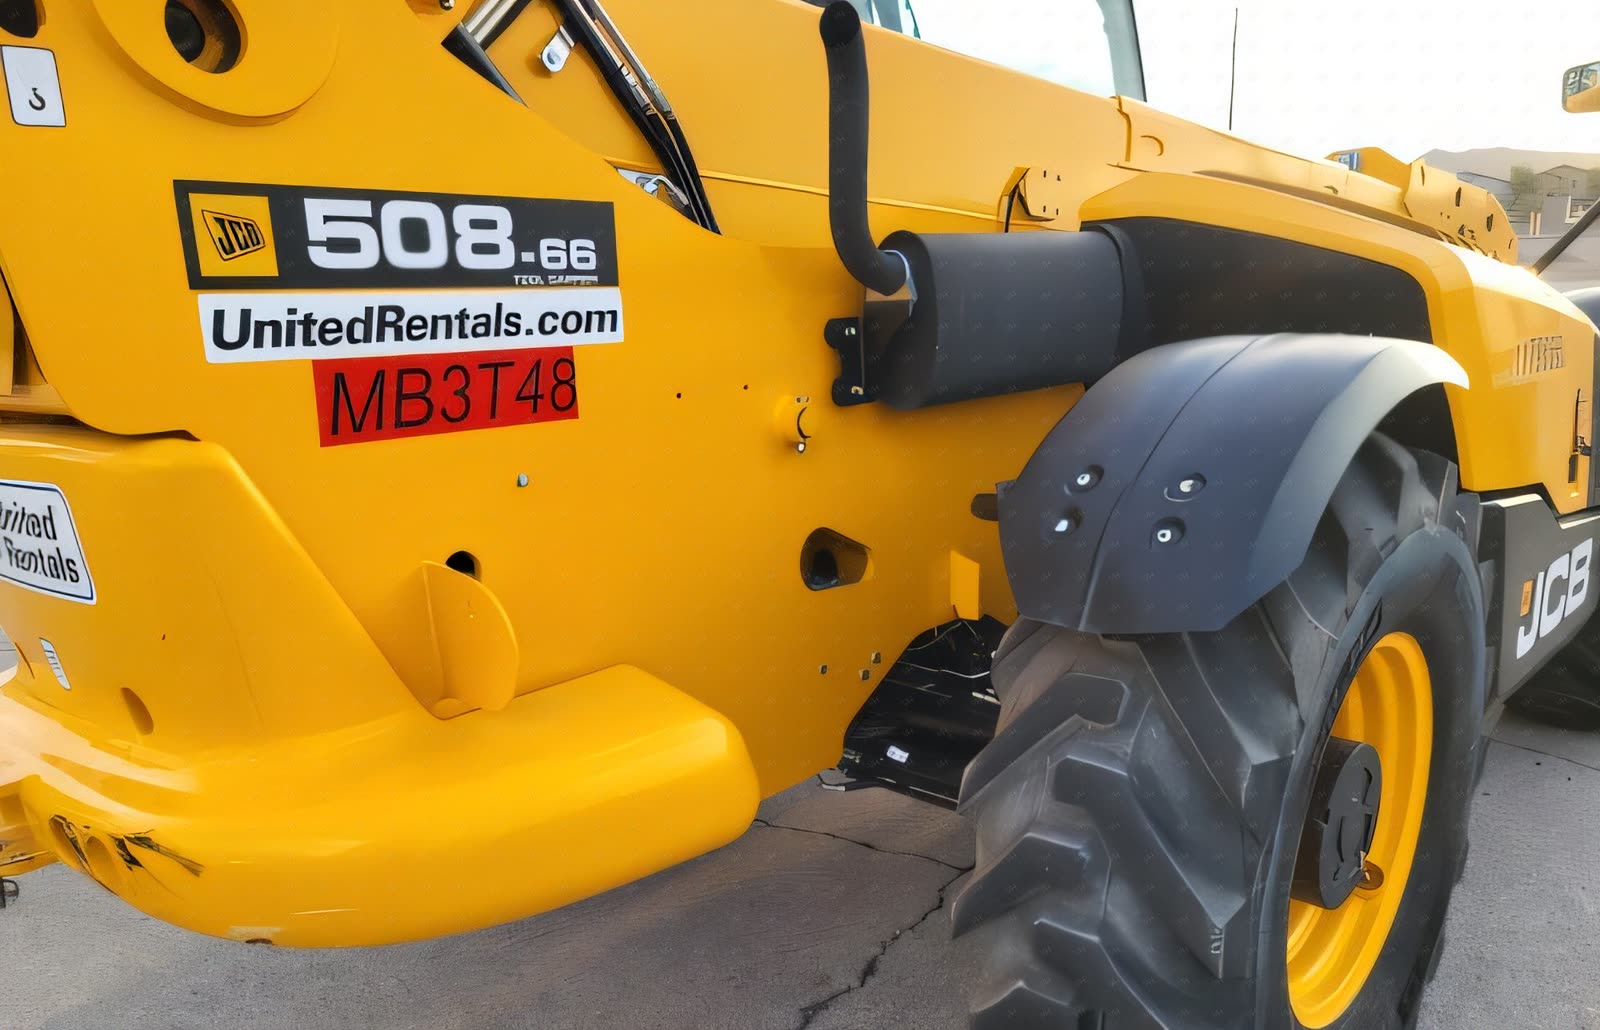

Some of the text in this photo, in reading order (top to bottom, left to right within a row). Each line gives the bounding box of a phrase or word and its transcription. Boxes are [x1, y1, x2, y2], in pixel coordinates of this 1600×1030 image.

[212, 302, 618, 350] UnitedRentals.com
[330, 357, 577, 436] MB3T48
[1516, 537, 1593, 660] JCB
